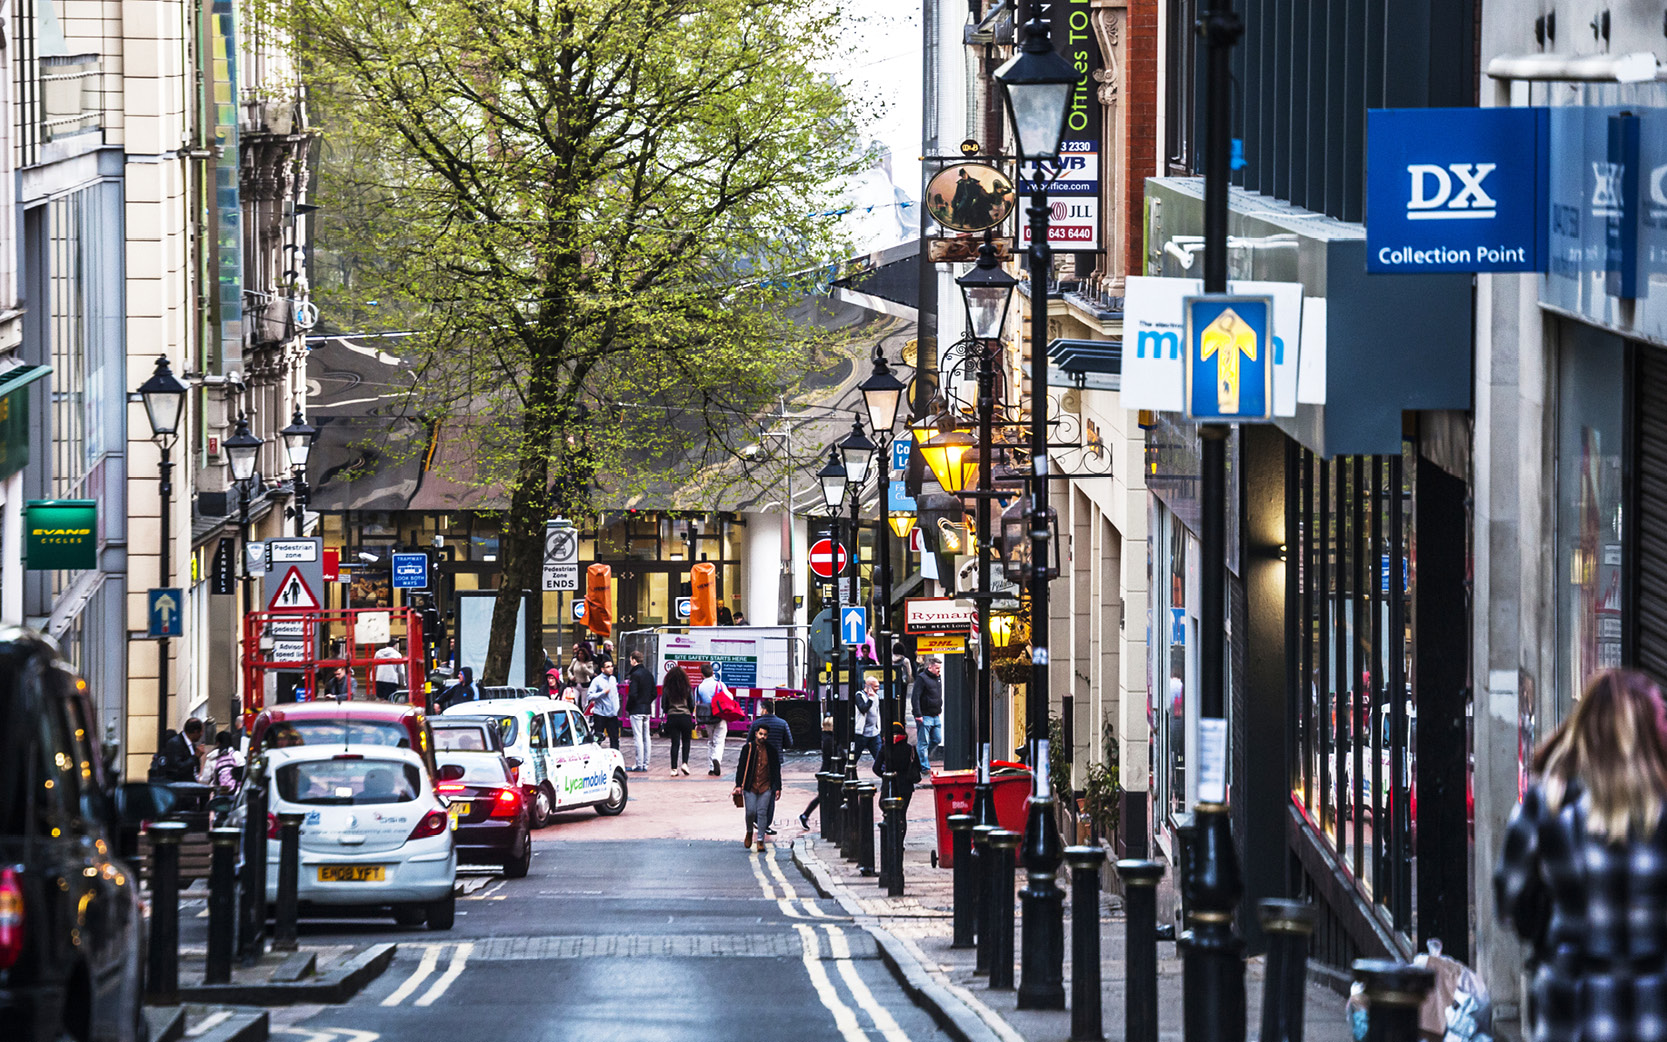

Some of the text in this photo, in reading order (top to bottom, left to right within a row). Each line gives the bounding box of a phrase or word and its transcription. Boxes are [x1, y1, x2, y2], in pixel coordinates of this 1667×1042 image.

[1068, 10, 1088, 131] Offices TO
[1068, 141, 1090, 151] 2330
[1406, 162, 1497, 210] DX
[1068, 205, 1093, 218] JLL
[1048, 228, 1066, 238] 643
[1067, 228, 1091, 238] 6440
[1378, 245, 1526, 265] Collection Point
[546, 579, 575, 588] ENDS
[564, 769, 607, 795] Lycamobile
[356, 867, 380, 880] YFT
